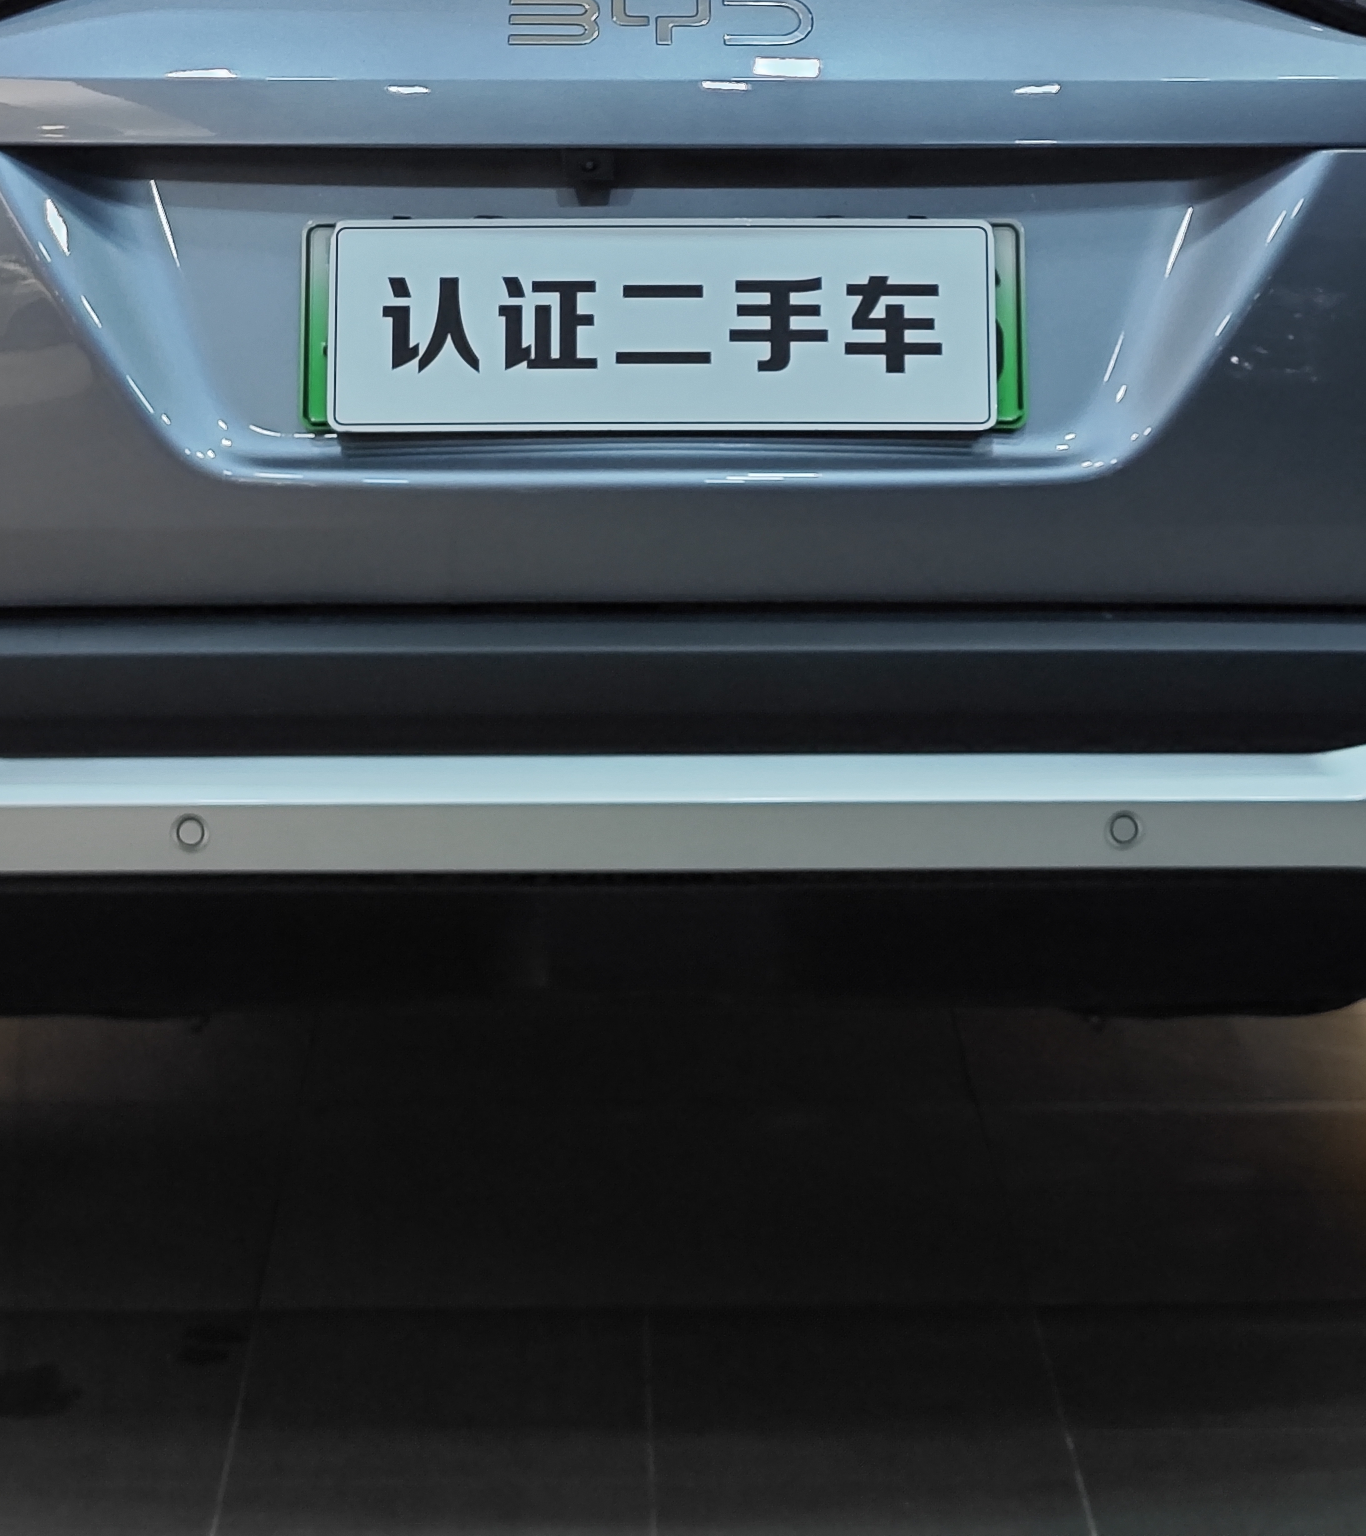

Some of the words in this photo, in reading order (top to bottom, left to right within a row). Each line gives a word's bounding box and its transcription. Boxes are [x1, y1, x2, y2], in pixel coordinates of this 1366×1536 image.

[382, 275, 943, 374] 认证二手车
